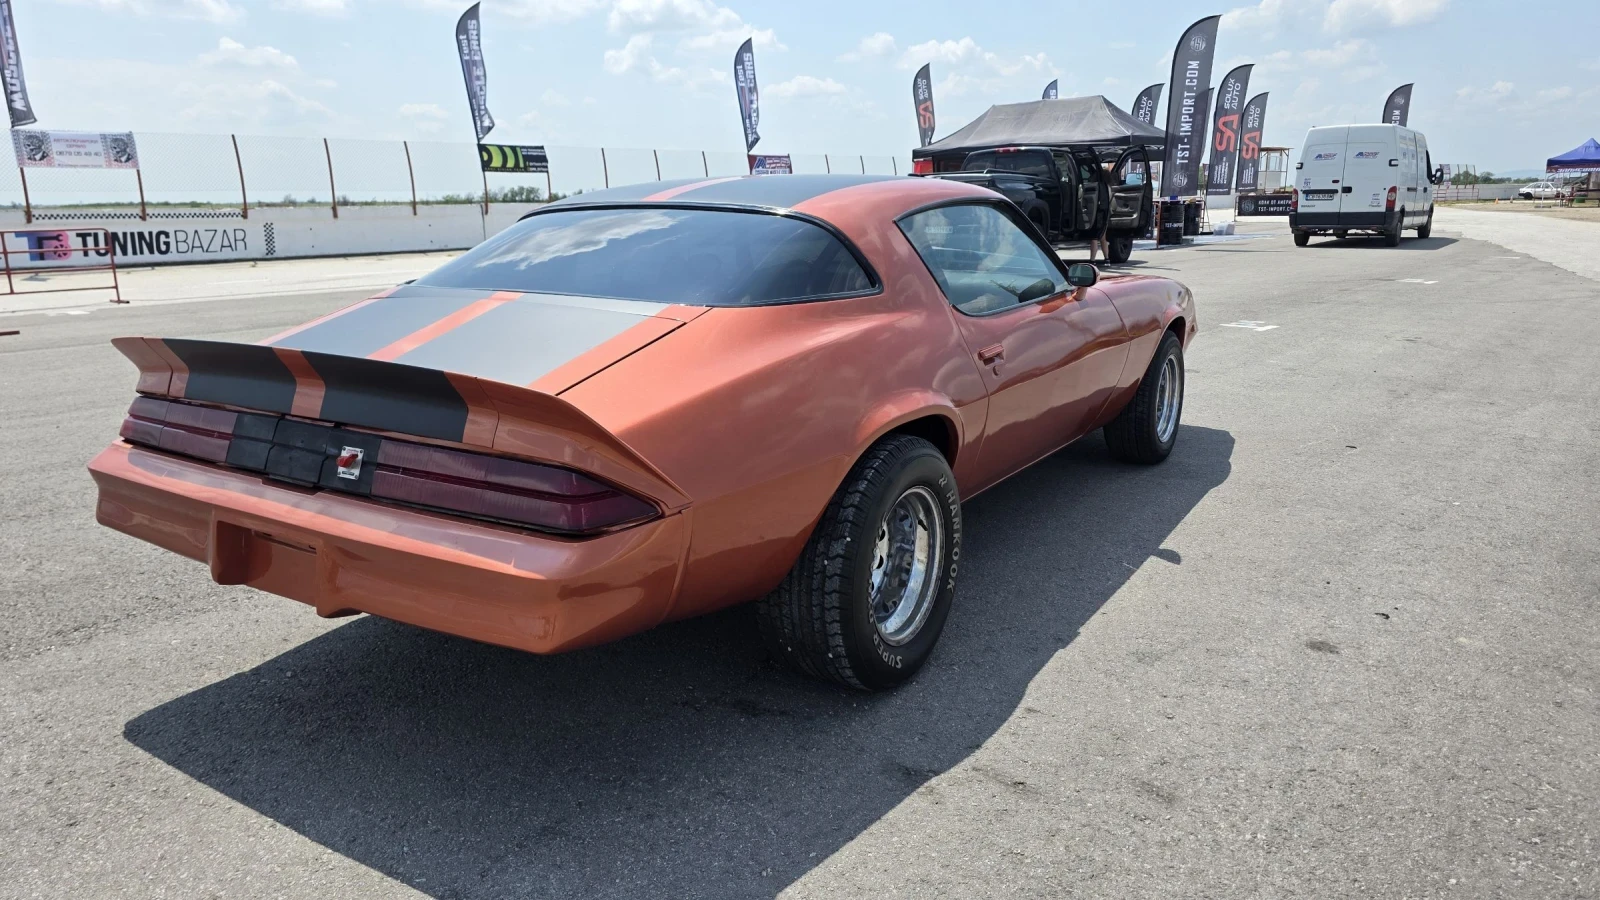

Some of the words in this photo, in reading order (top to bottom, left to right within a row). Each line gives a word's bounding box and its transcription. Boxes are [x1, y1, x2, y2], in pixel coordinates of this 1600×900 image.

[459, 34, 470, 60] Fest
[468, 20, 481, 61] CARS
[737, 65, 746, 87] Fest
[1224, 78, 1235, 110] SOLUX
[1231, 83, 1241, 110] AUTO
[1144, 100, 1153, 123] AUTO
[1177, 60, 1200, 165] TST-IMPORT.COM
[1247, 104, 1256, 128] SOLUX
[945, 488, 963, 595] HANKOOK
[873, 632, 903, 669] SUPER
